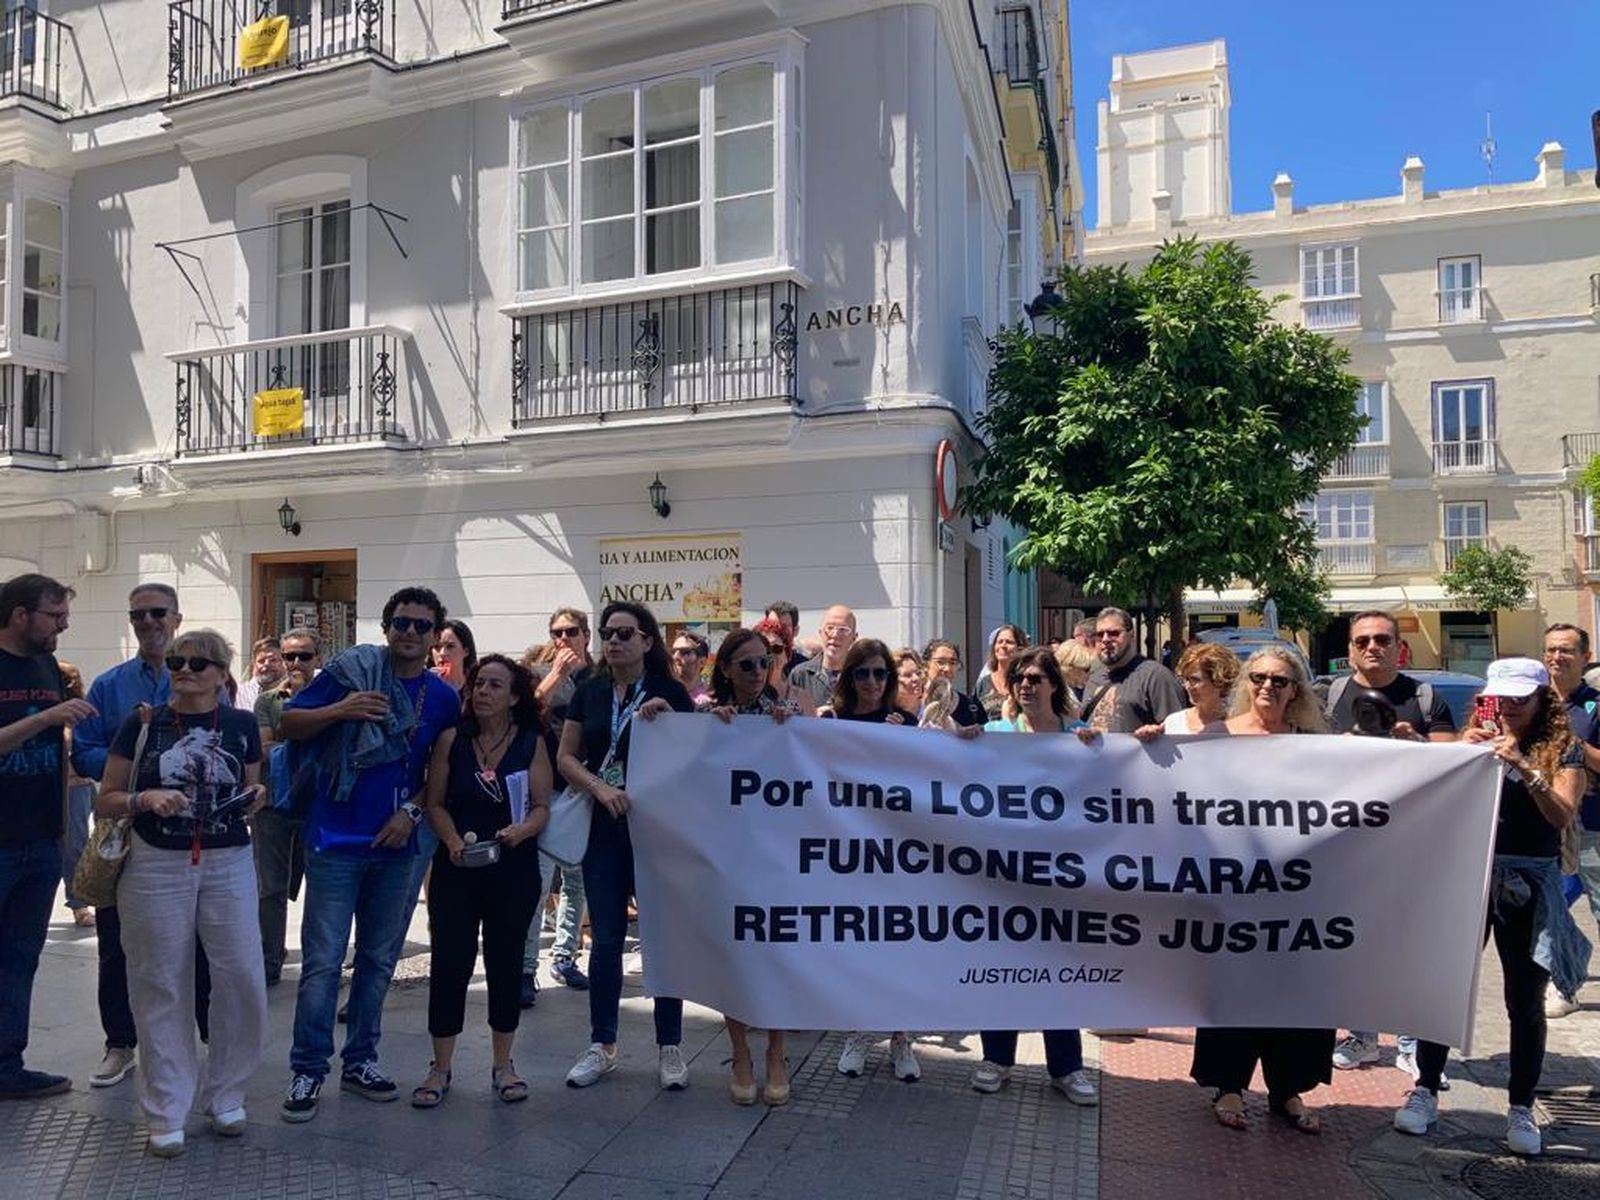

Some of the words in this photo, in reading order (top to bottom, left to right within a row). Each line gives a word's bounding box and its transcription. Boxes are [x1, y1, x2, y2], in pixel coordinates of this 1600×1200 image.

[806, 302, 906, 331] ANCHA
[620, 551, 631, 562] Y
[633, 547, 739, 563] ALIMENTACION
[730, 770, 812, 807] Por
[828, 781, 912, 812] una
[931, 781, 1065, 821] LOEO
[1084, 789, 1154, 824] sin
[1173, 792, 1390, 834] trampas
[799, 838, 1087, 889] FUNCIONES
[1104, 854, 1312, 894] CLARAS
[734, 904, 1141, 946] RETRIBUCIONES
[1158, 917, 1355, 953] JUSTAS
[959, 968, 1051, 985] JUSTICIA
[1058, 964, 1124, 984] CÁDIZ
